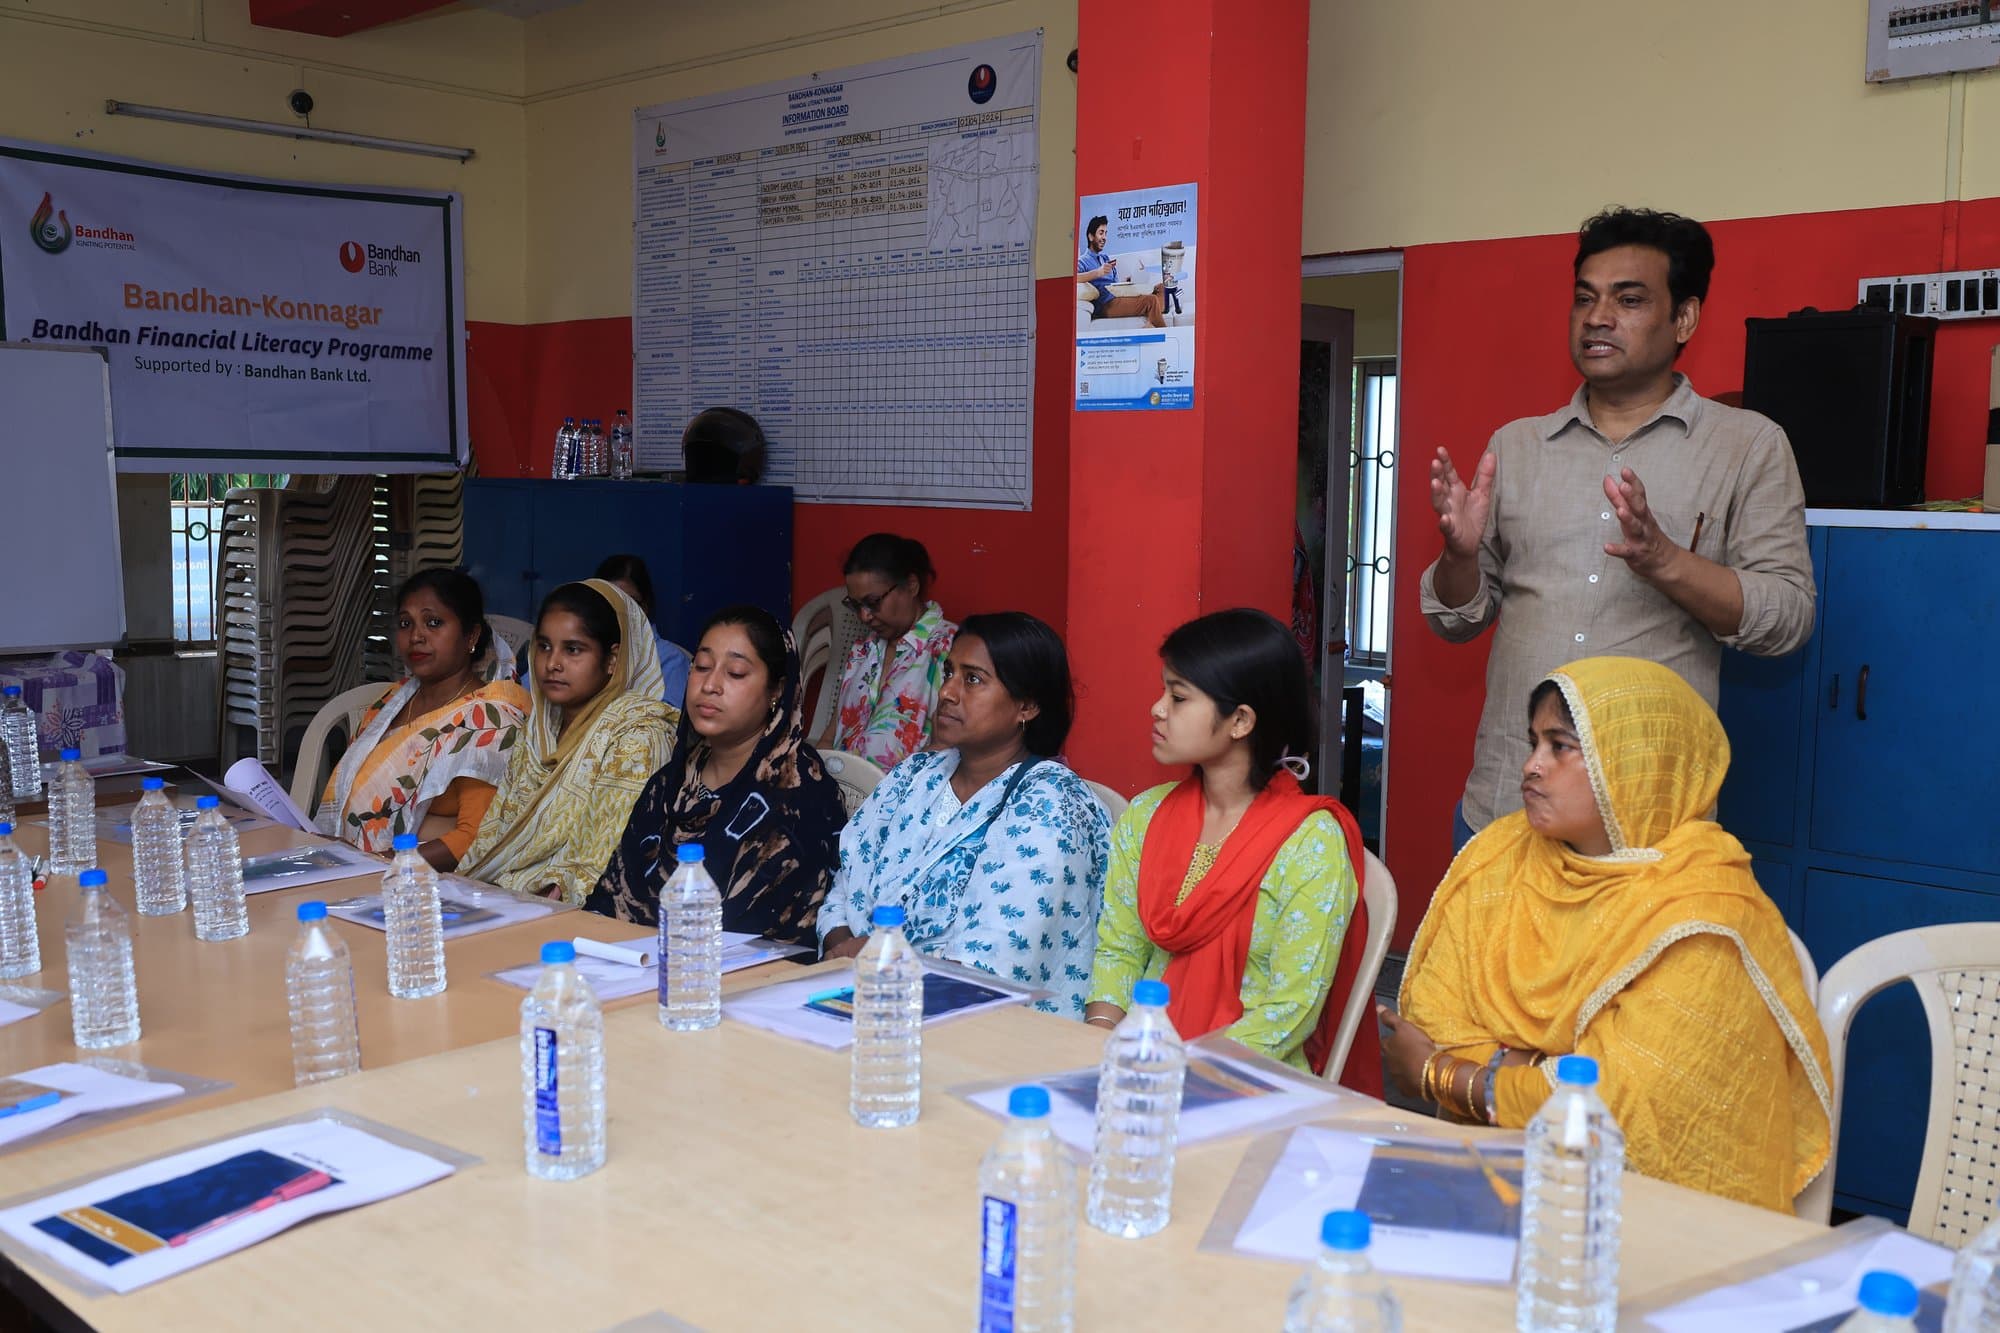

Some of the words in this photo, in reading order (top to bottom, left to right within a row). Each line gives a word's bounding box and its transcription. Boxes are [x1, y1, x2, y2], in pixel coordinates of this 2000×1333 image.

[783, 108, 825, 124] INFORMATION
[827, 105, 848, 117] BOARD
[1133, 205, 1147, 218] যান
[75, 225, 134, 242] Bandhan
[368, 244, 420, 264] Bandhan
[369, 259, 398, 277] Bank
[123, 283, 383, 329] Bandhan-Konnagar
[32, 319, 131, 346] Bandhan
[137, 326, 236, 351] Financial
[241, 332, 324, 358] Literacy
[328, 337, 433, 361] Programme
[135, 355, 211, 375] Supported
[215, 359, 233, 377] by
[244, 363, 306, 379] Bandhan
[310, 366, 343, 382] Bank
[347, 369, 371, 383] Ltd.
